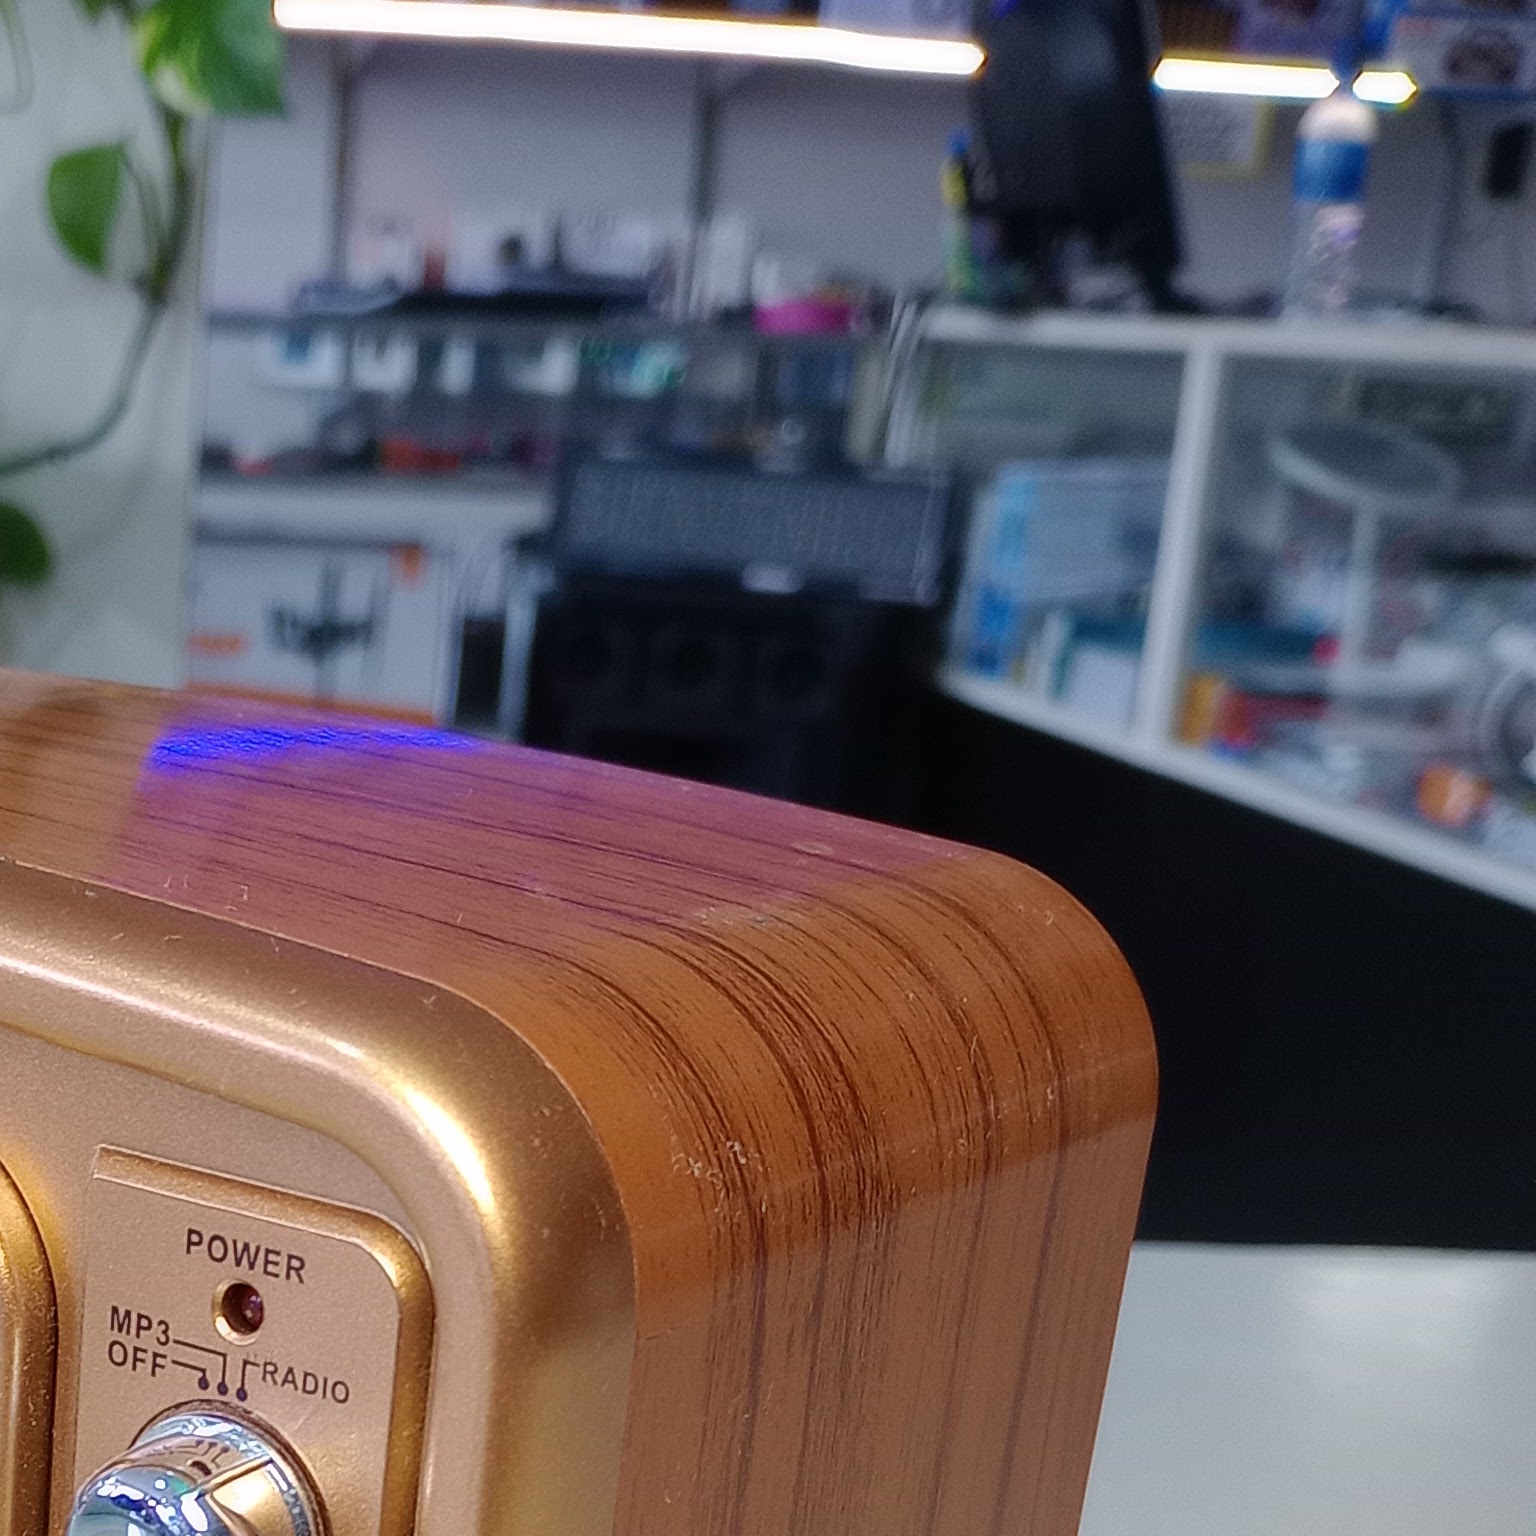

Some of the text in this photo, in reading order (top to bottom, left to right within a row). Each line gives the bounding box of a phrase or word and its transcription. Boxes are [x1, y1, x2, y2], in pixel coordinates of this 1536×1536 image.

[186, 1228, 306, 1284] POWER
[110, 1305, 170, 1347] MP3
[108, 1340, 167, 1378] OFF
[261, 1361, 350, 1404] RADIO
